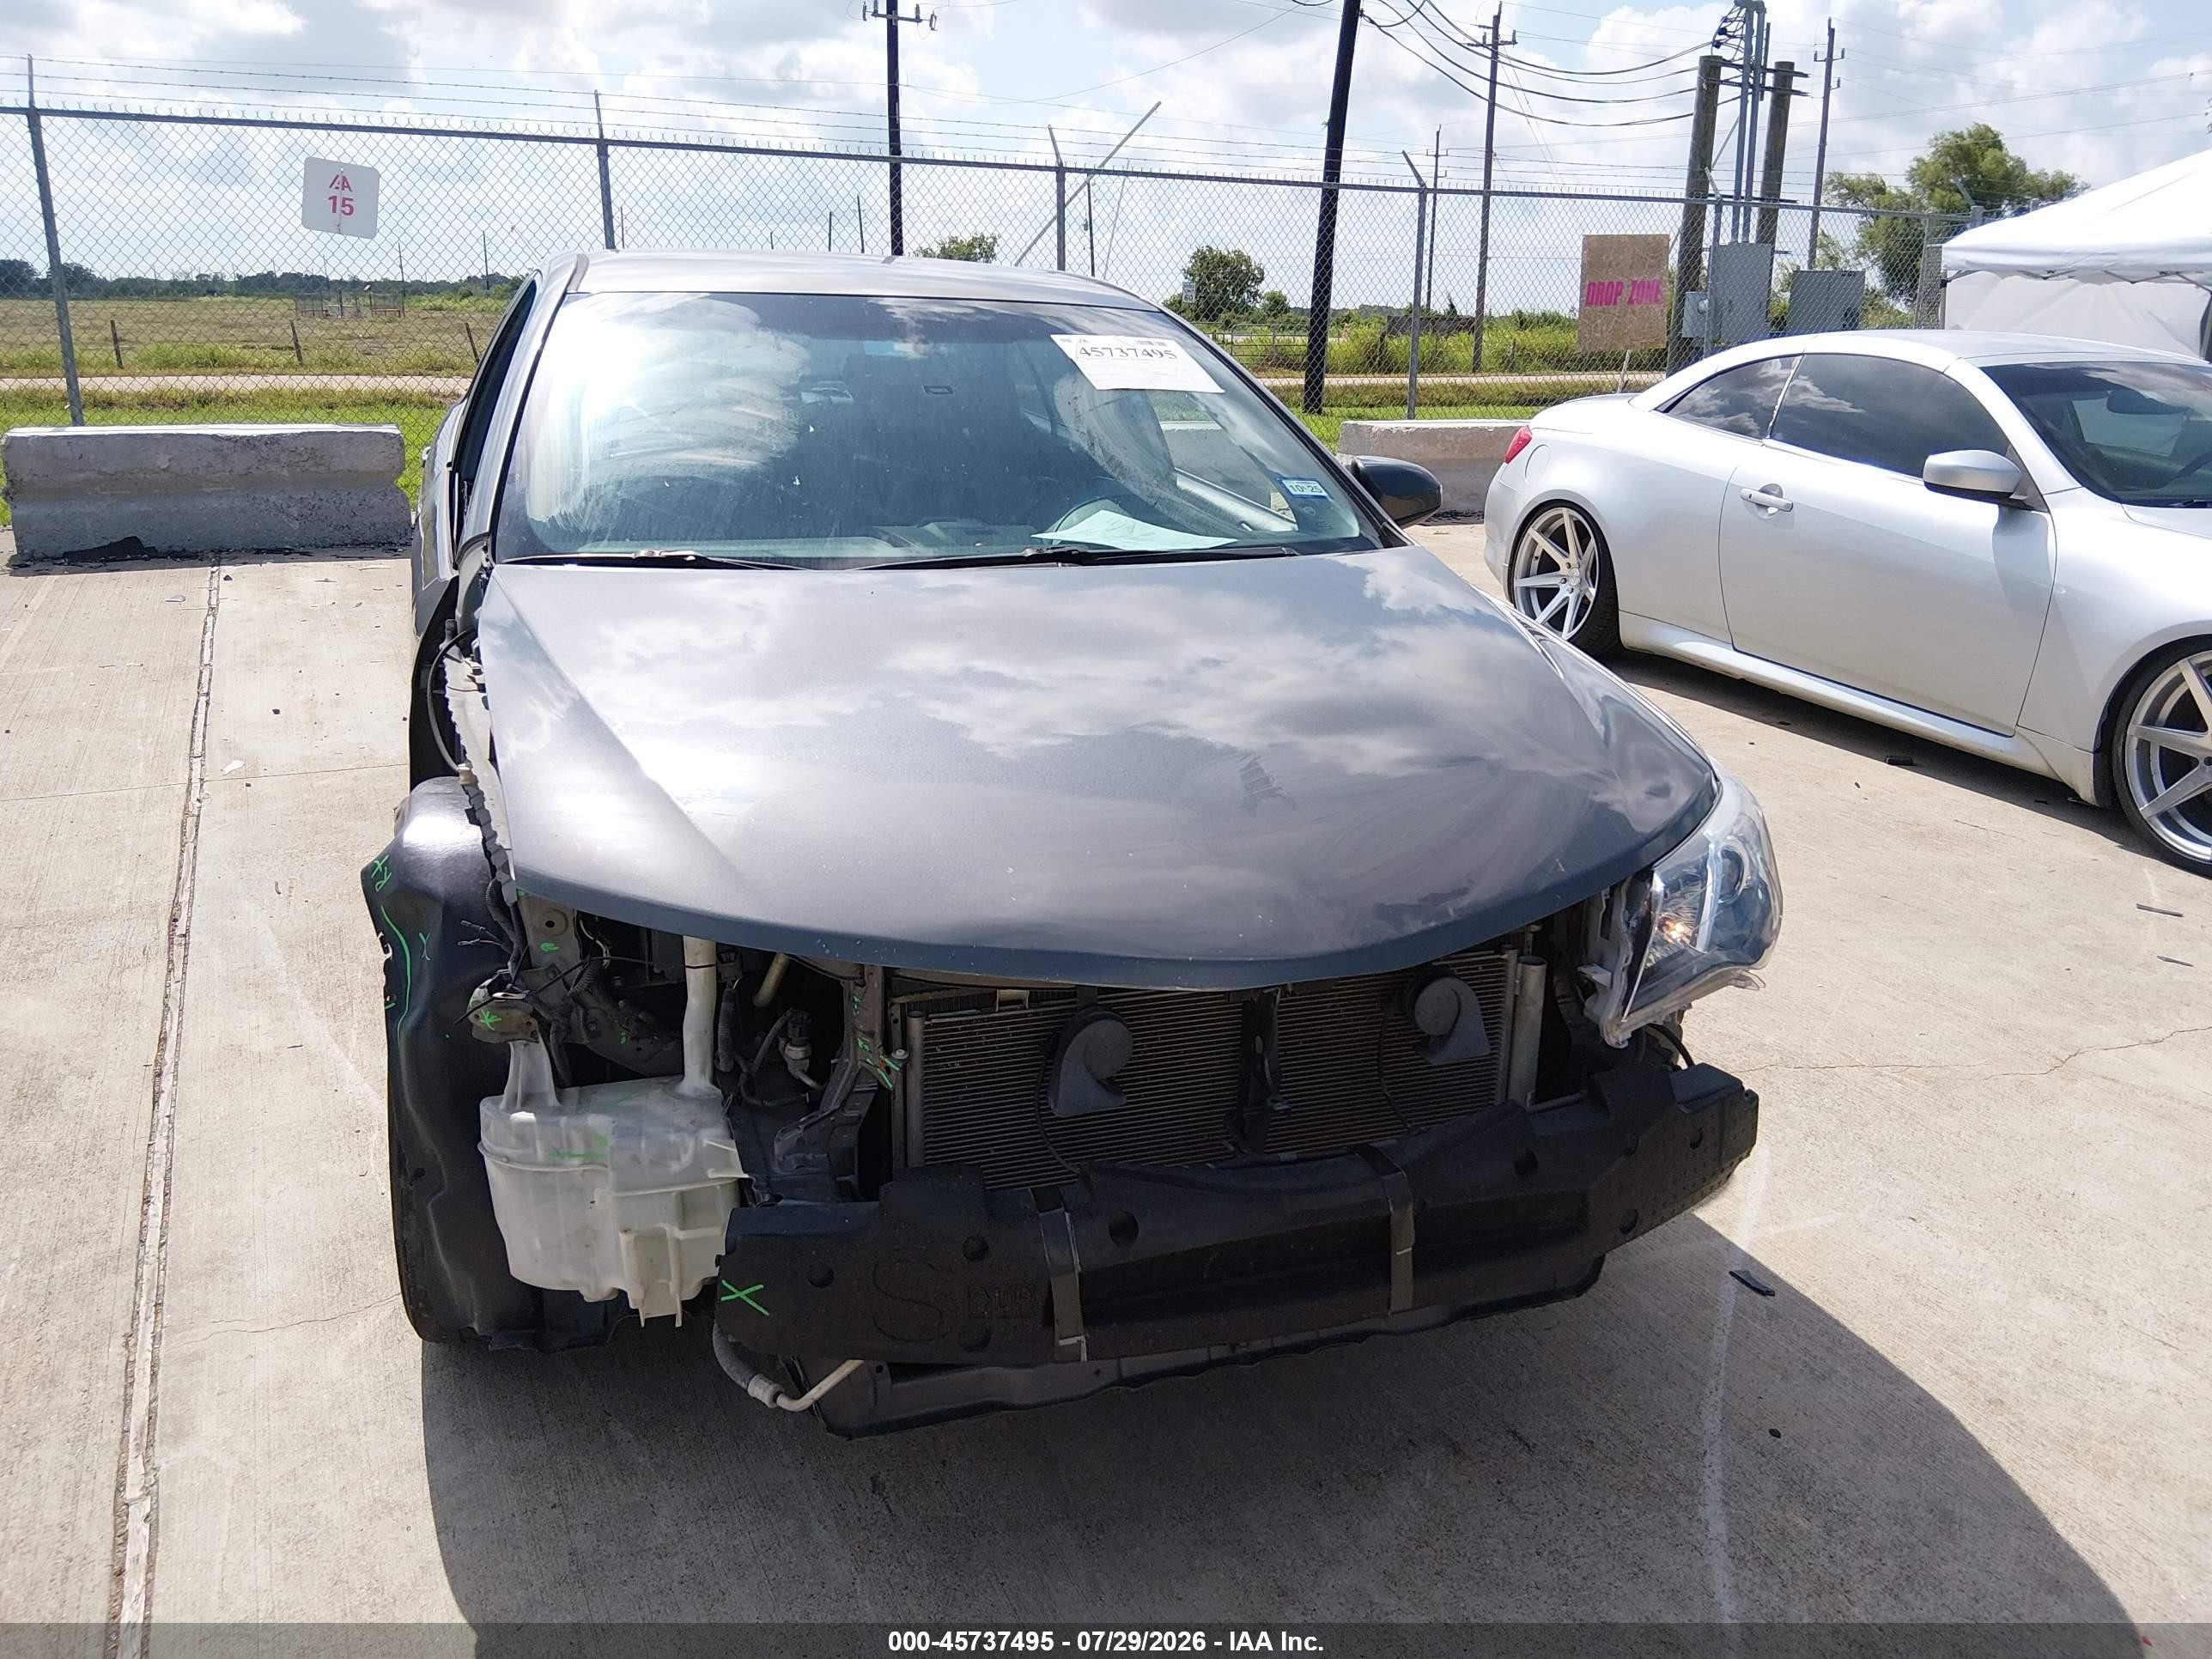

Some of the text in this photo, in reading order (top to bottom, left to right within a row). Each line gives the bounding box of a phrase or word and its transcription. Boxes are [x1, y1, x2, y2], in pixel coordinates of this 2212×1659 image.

[328, 195, 355, 216] 15
[1584, 280, 1662, 307] DROP ZONE
